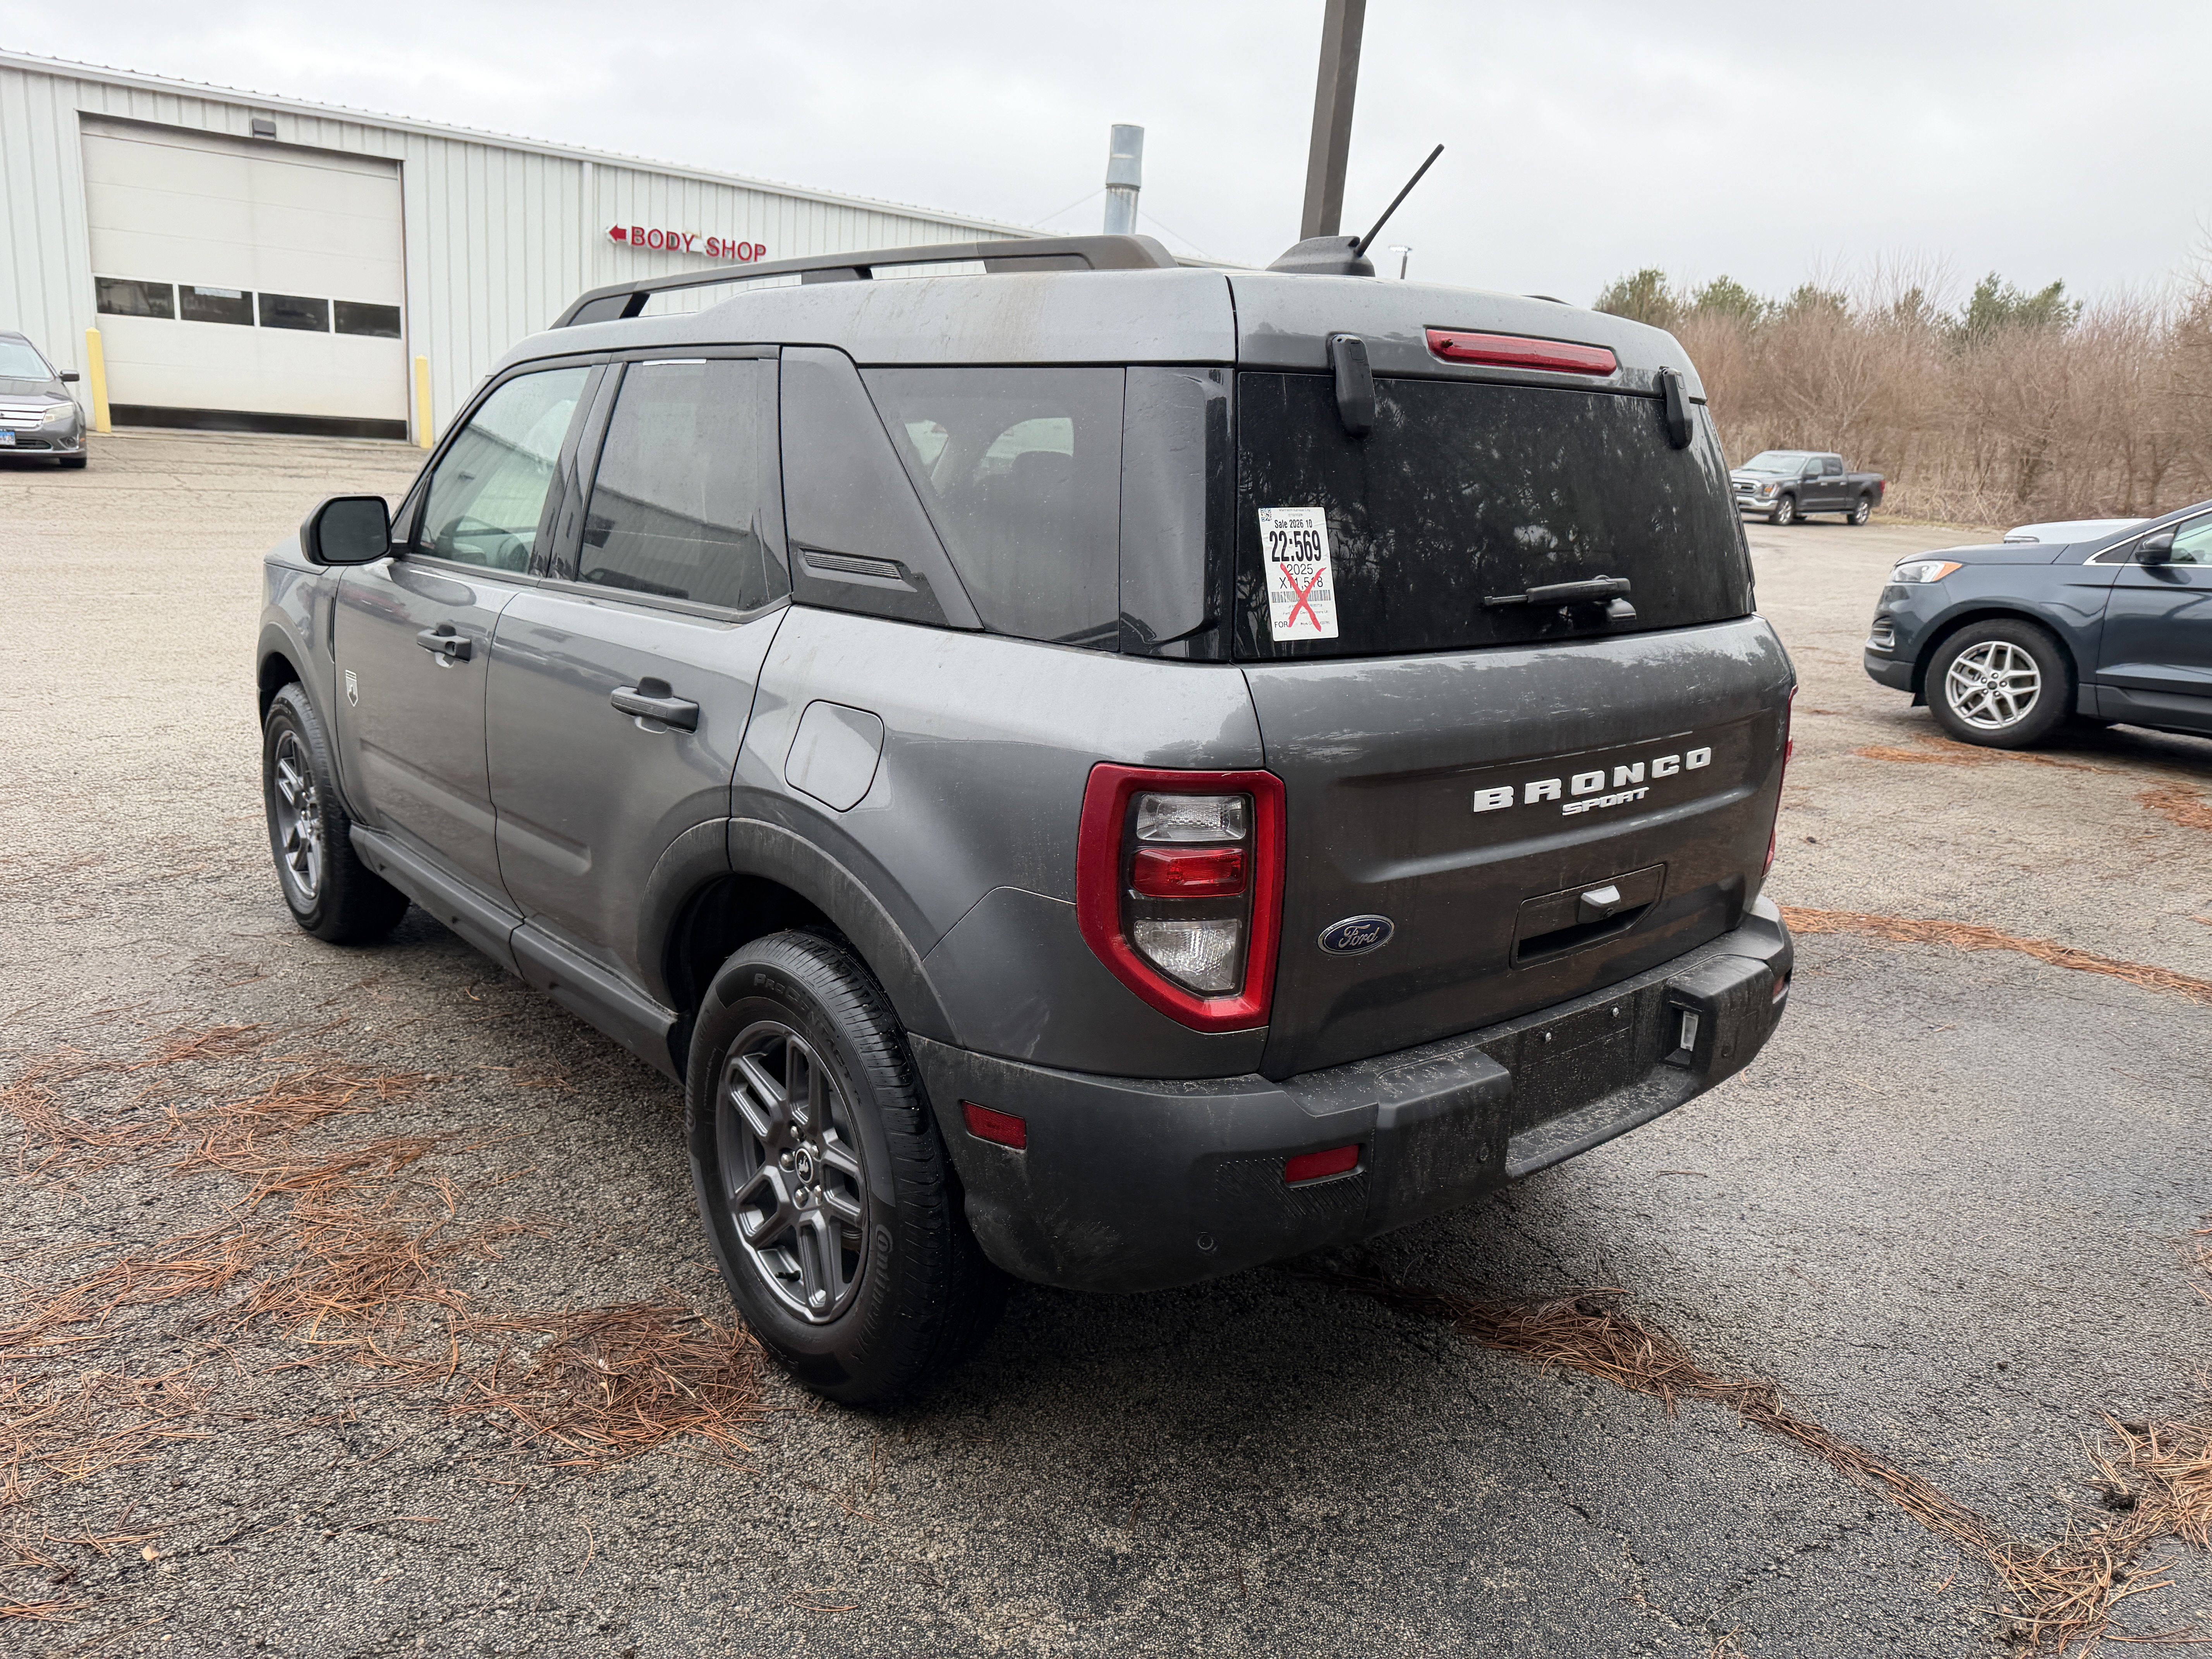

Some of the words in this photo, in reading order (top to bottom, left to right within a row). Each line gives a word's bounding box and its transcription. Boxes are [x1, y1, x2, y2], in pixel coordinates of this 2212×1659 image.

[631, 226, 695, 254] BODY
[706, 237, 767, 262] SHOP
[1274, 520, 1288, 528] Sale
[1289, 519, 1304, 528] 2026
[1306, 519, 1312, 527] 10
[1269, 530, 1321, 562] 22:569
[1287, 564, 1313, 575] 2025
[1473, 747, 1712, 812] BRONCO
[1562, 787, 1650, 816] SPORT
[1338, 924, 1380, 948] Ford
